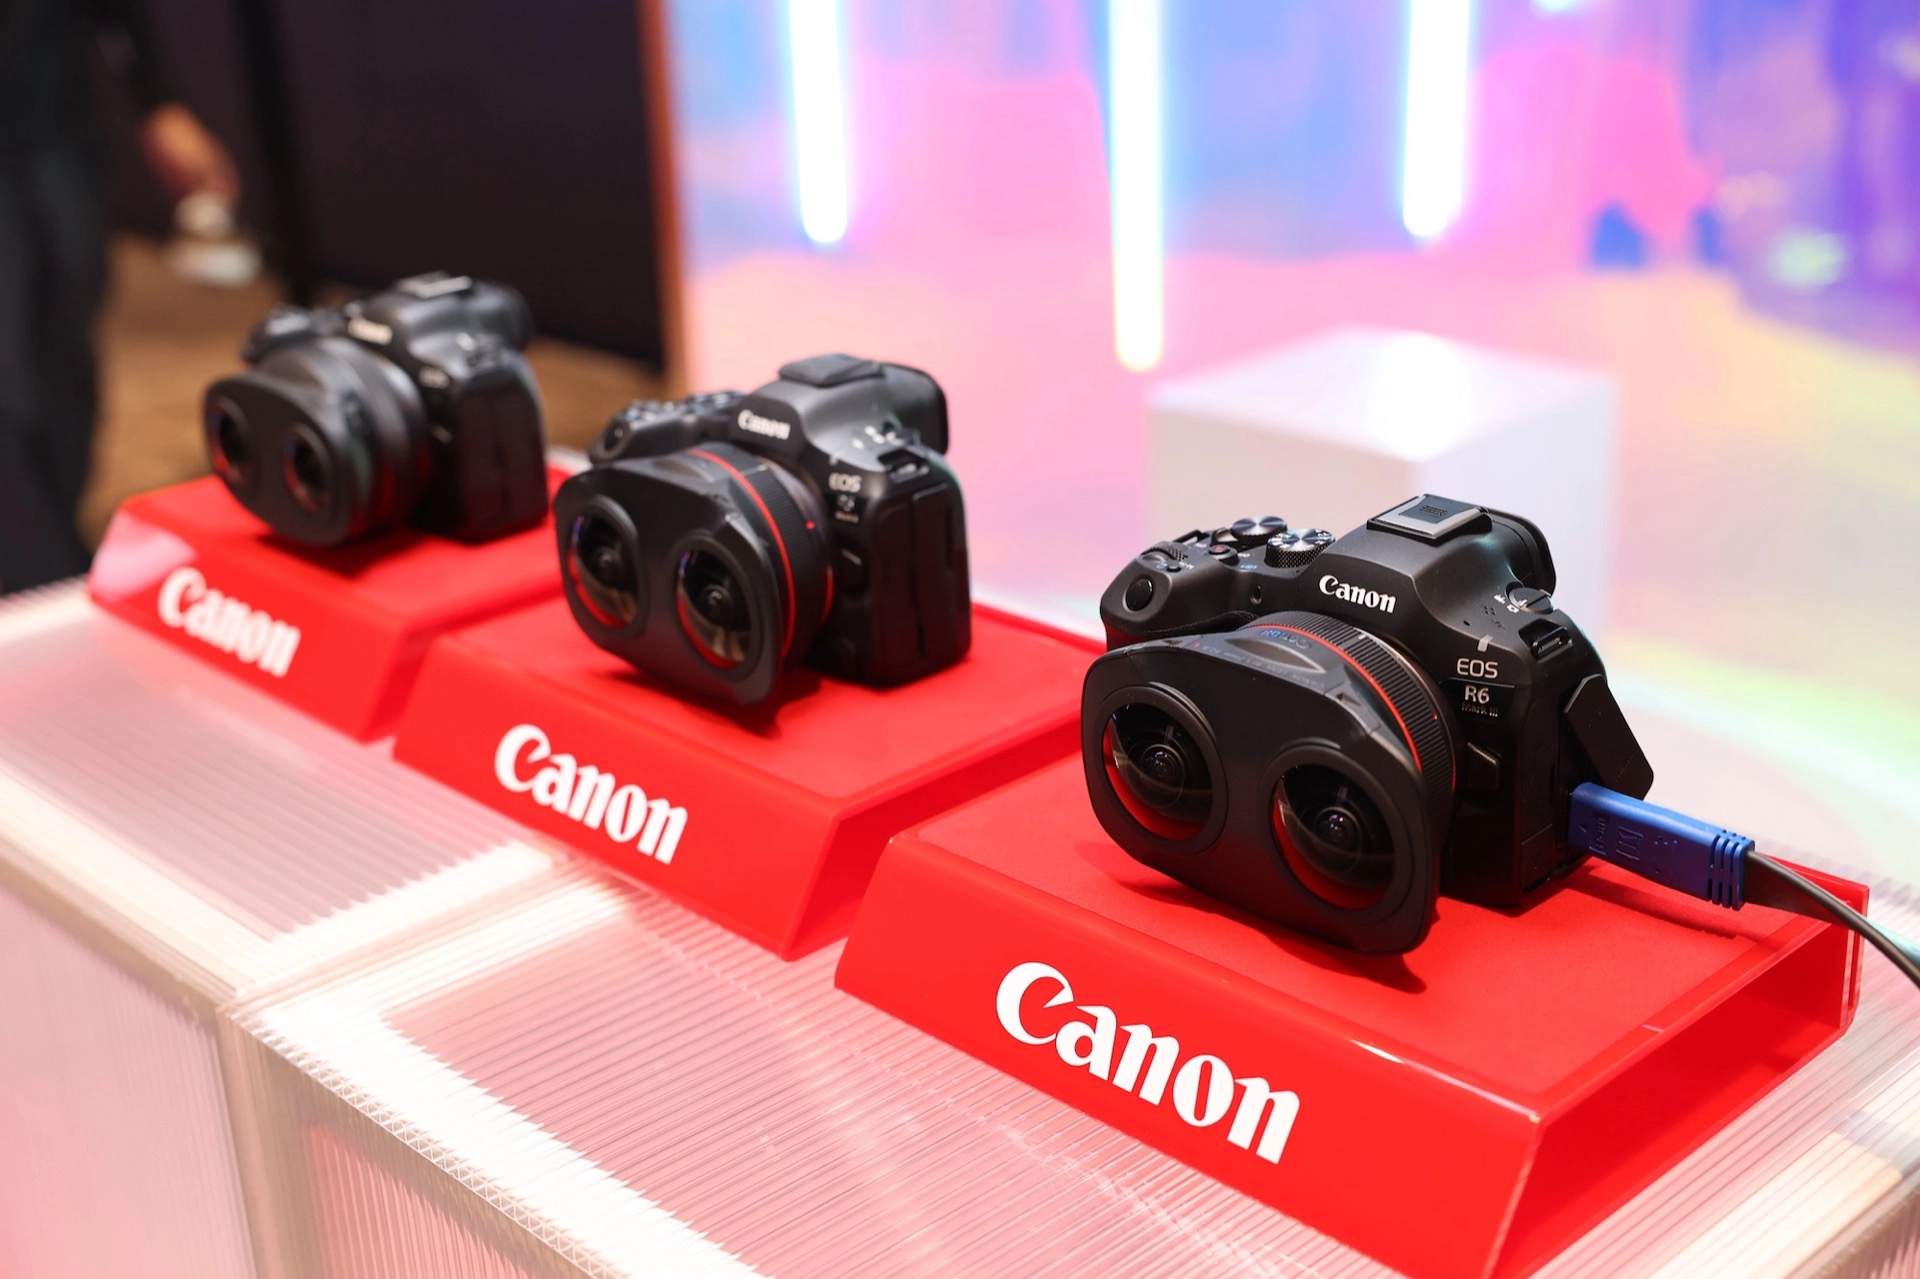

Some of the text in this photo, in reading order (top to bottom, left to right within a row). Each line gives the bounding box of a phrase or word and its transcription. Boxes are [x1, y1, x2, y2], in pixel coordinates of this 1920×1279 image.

[737, 408, 791, 440] Canon
[828, 471, 862, 493] EOS
[1319, 574, 1397, 614] Canon
[157, 566, 301, 678] Canon
[1456, 657, 1499, 679] EOS
[1464, 684, 1490, 704] R6
[494, 723, 688, 865] Canon
[996, 961, 1300, 1165] Canon
